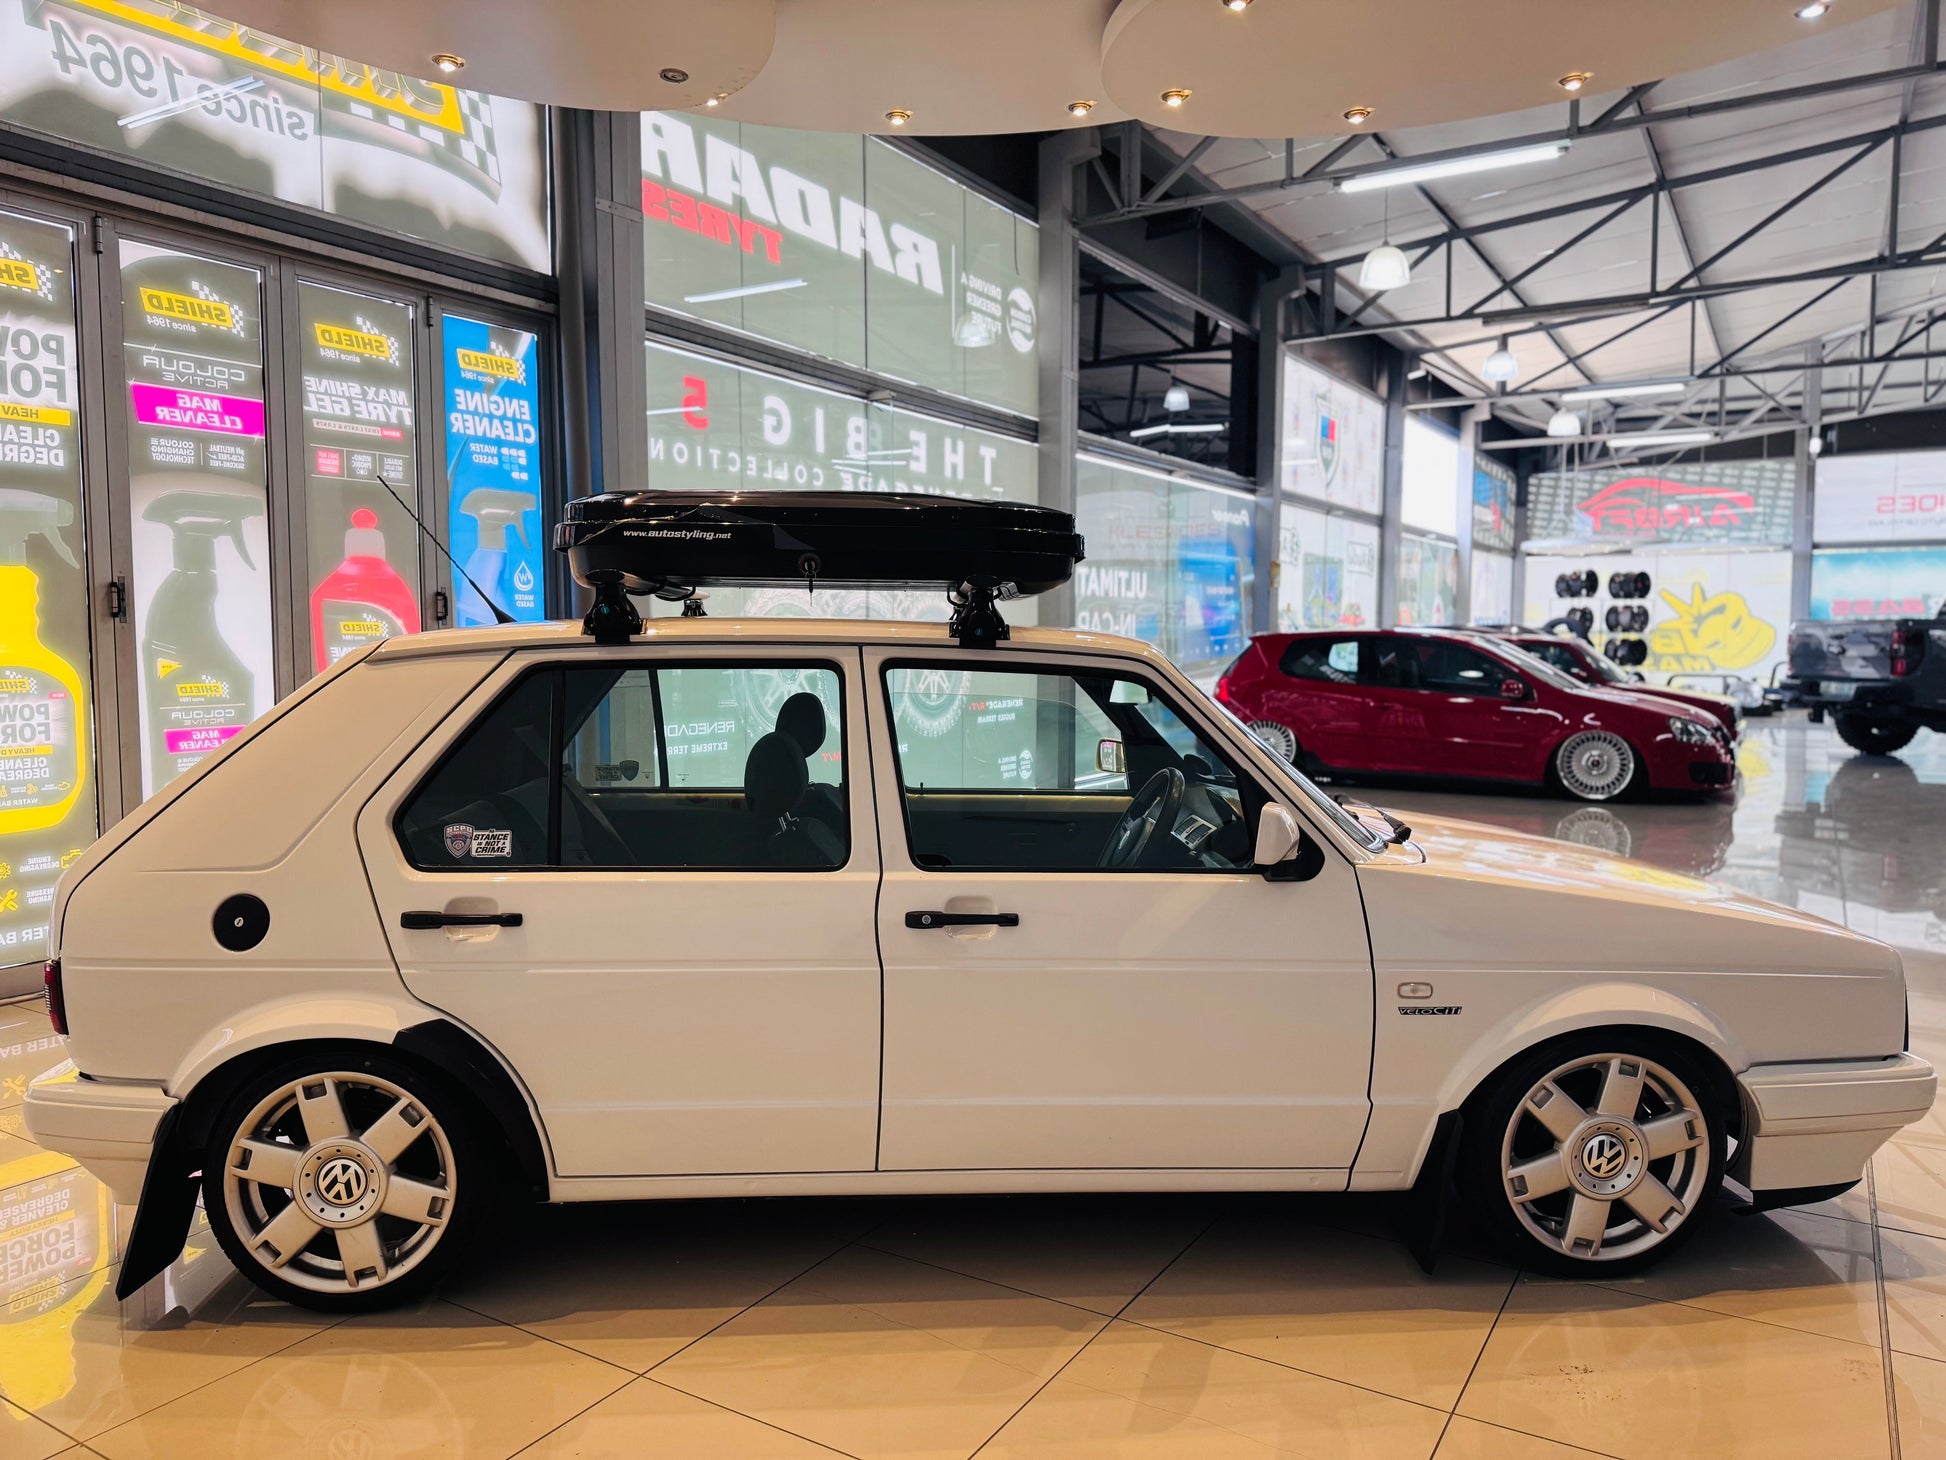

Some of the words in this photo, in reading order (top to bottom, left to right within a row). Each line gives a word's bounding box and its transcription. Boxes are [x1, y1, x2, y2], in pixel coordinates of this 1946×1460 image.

[623, 530, 732, 540] www.autostyling.net
[473, 833, 509, 841] STANCE
[475, 846, 507, 854] CRIME
